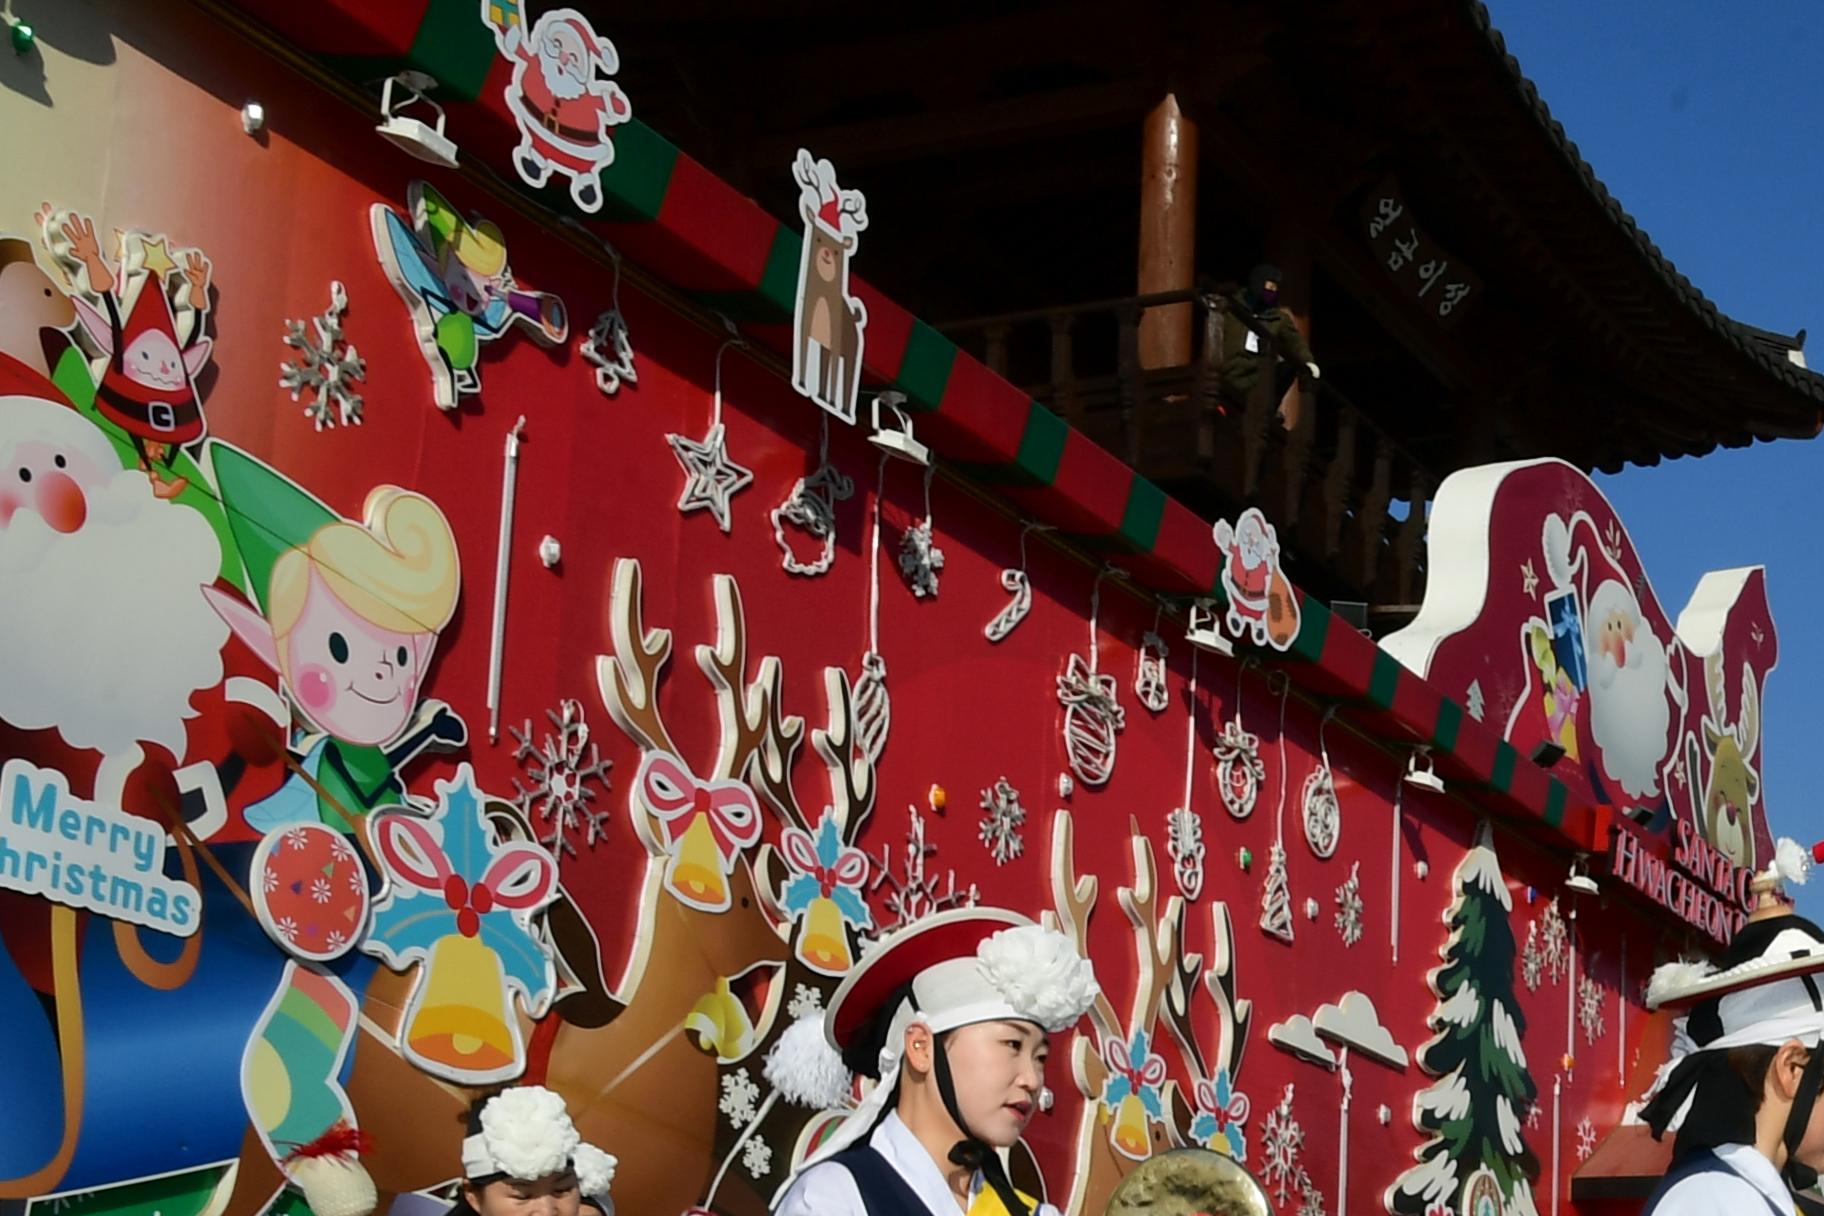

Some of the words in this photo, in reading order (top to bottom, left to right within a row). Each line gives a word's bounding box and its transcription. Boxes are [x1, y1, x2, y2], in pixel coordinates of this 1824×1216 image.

[11, 773, 155, 872] Merry
[1674, 817, 1736, 901] SANTA
[0, 836, 190, 926] hristmas
[1612, 823, 1733, 946] HWACHEON
